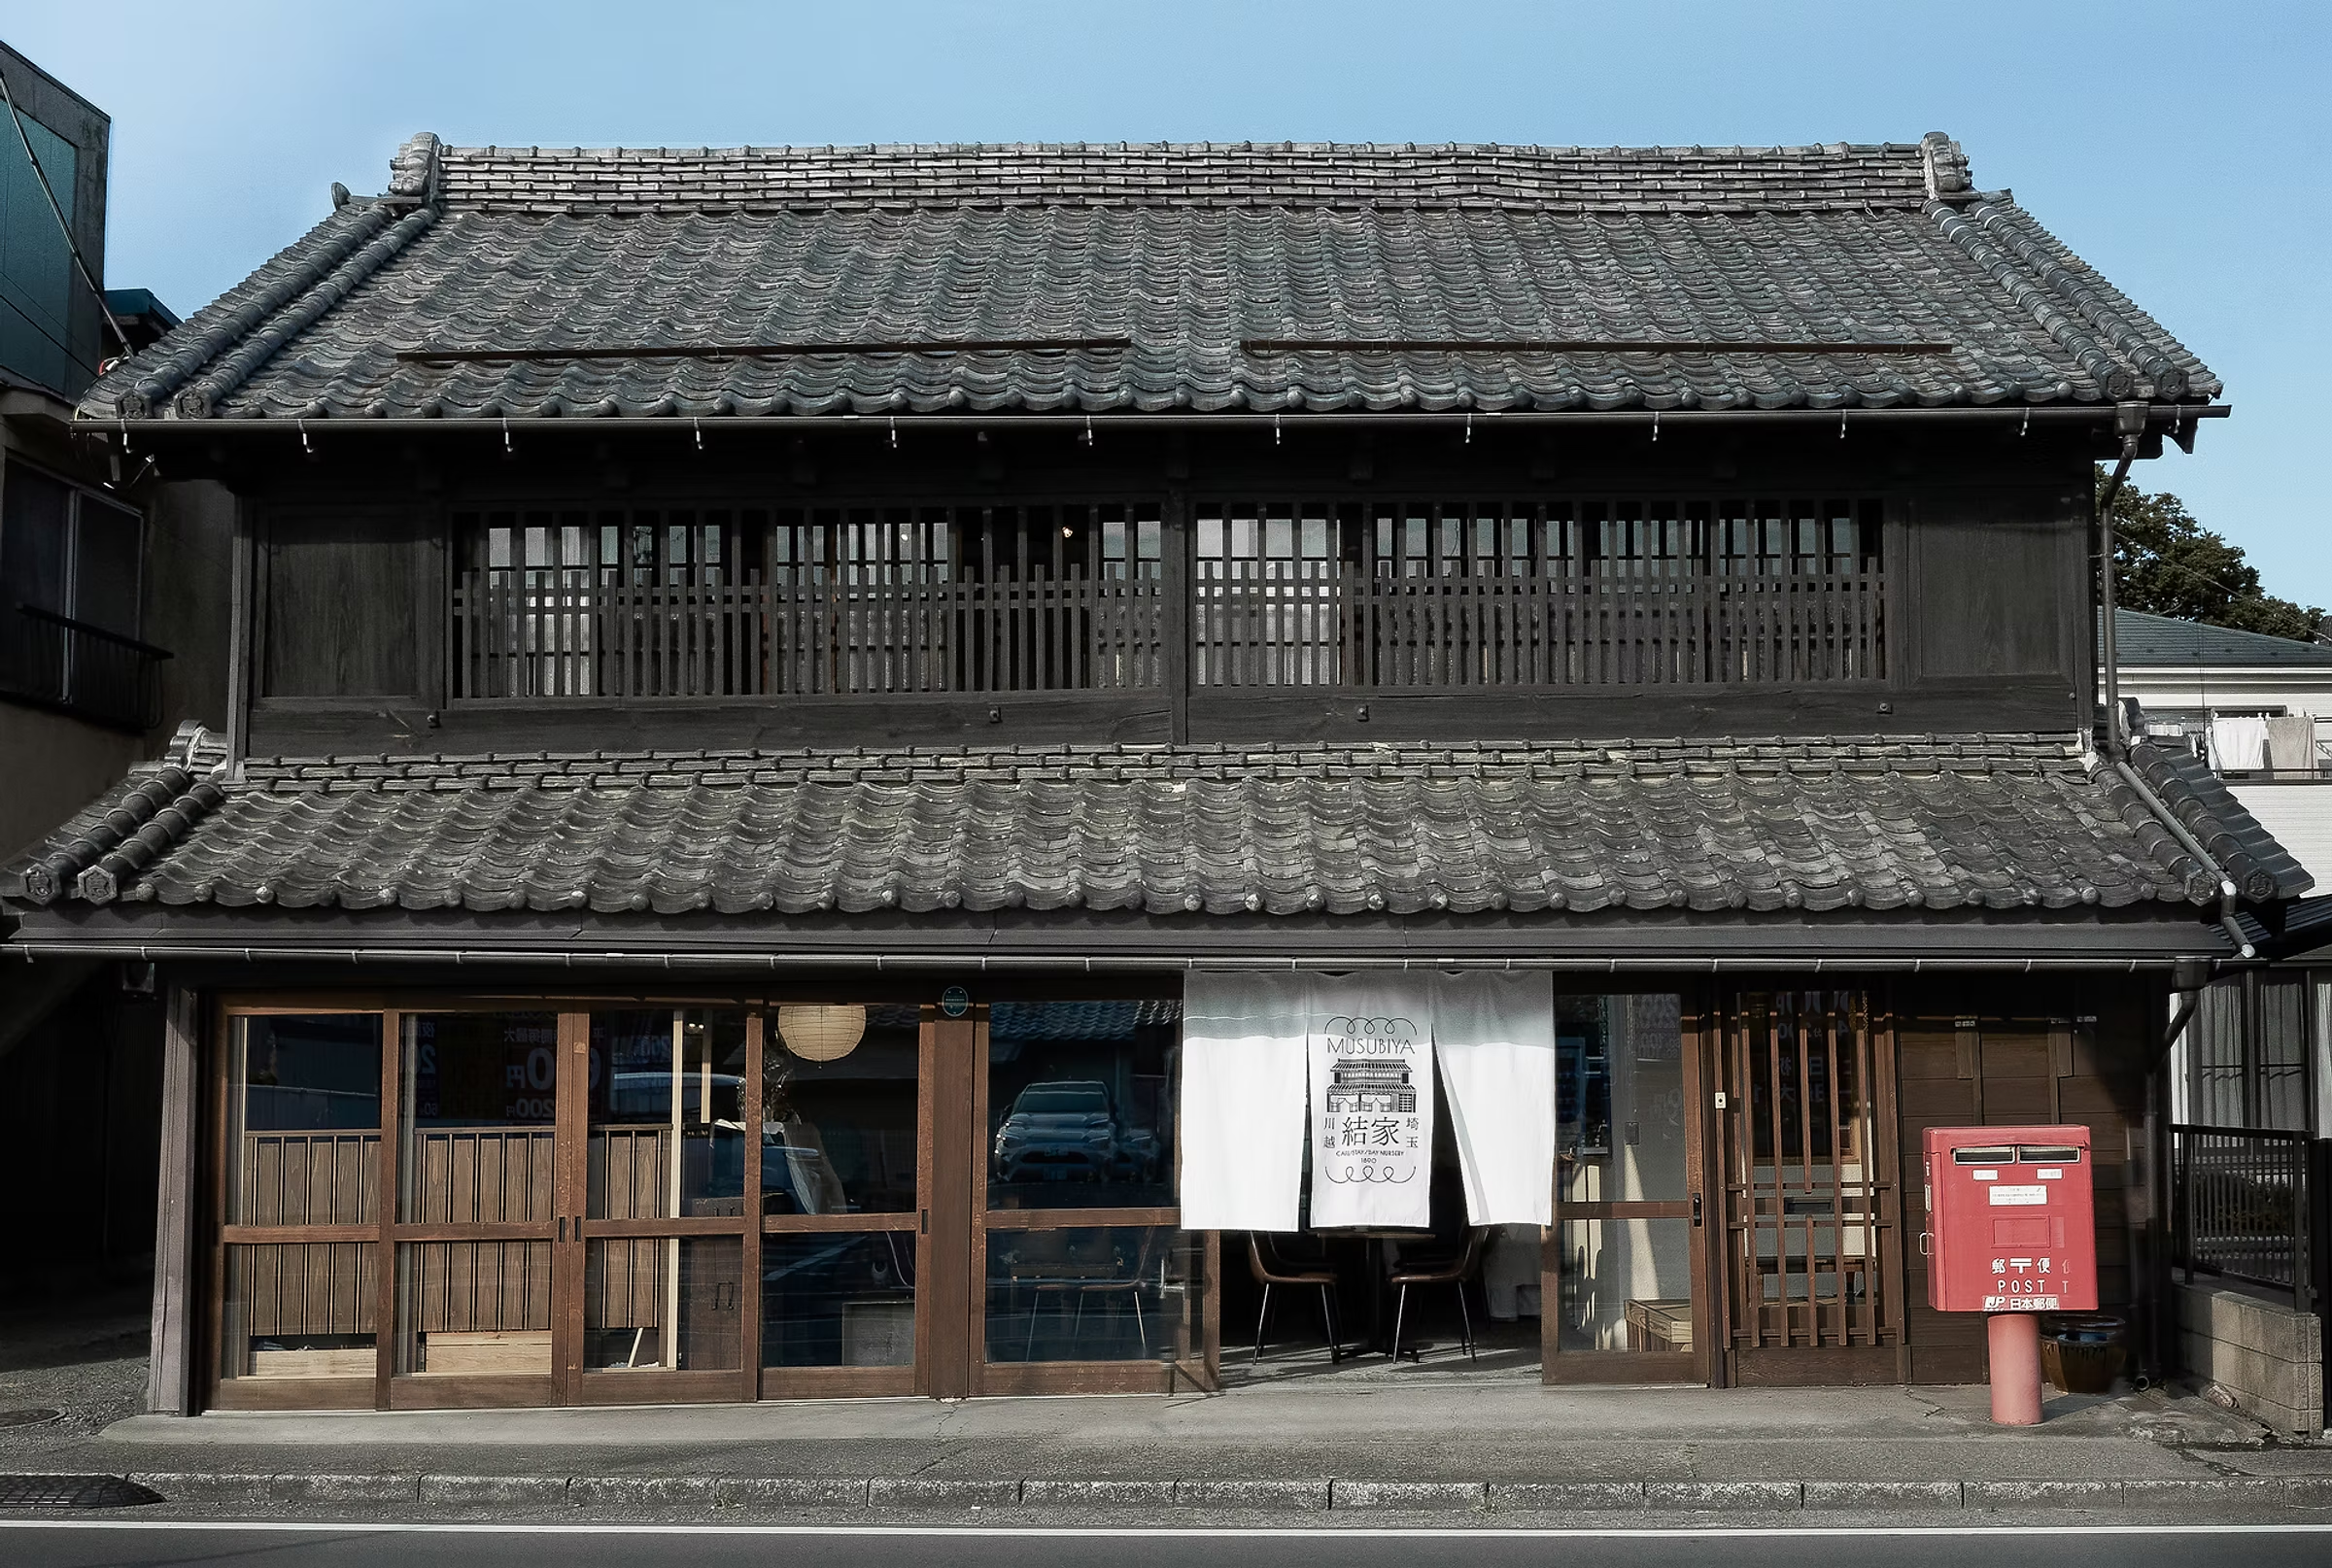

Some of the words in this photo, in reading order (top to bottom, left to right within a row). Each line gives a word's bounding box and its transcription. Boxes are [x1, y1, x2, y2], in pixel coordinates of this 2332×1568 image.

[1326, 1038, 1416, 1054] MUSUBIYA
[1322, 1117, 1336, 1148] 川越
[1341, 1115, 1400, 1147] 結家
[1406, 1117, 1420, 1149] 埼玉
[1998, 1279, 2045, 1293] POST
